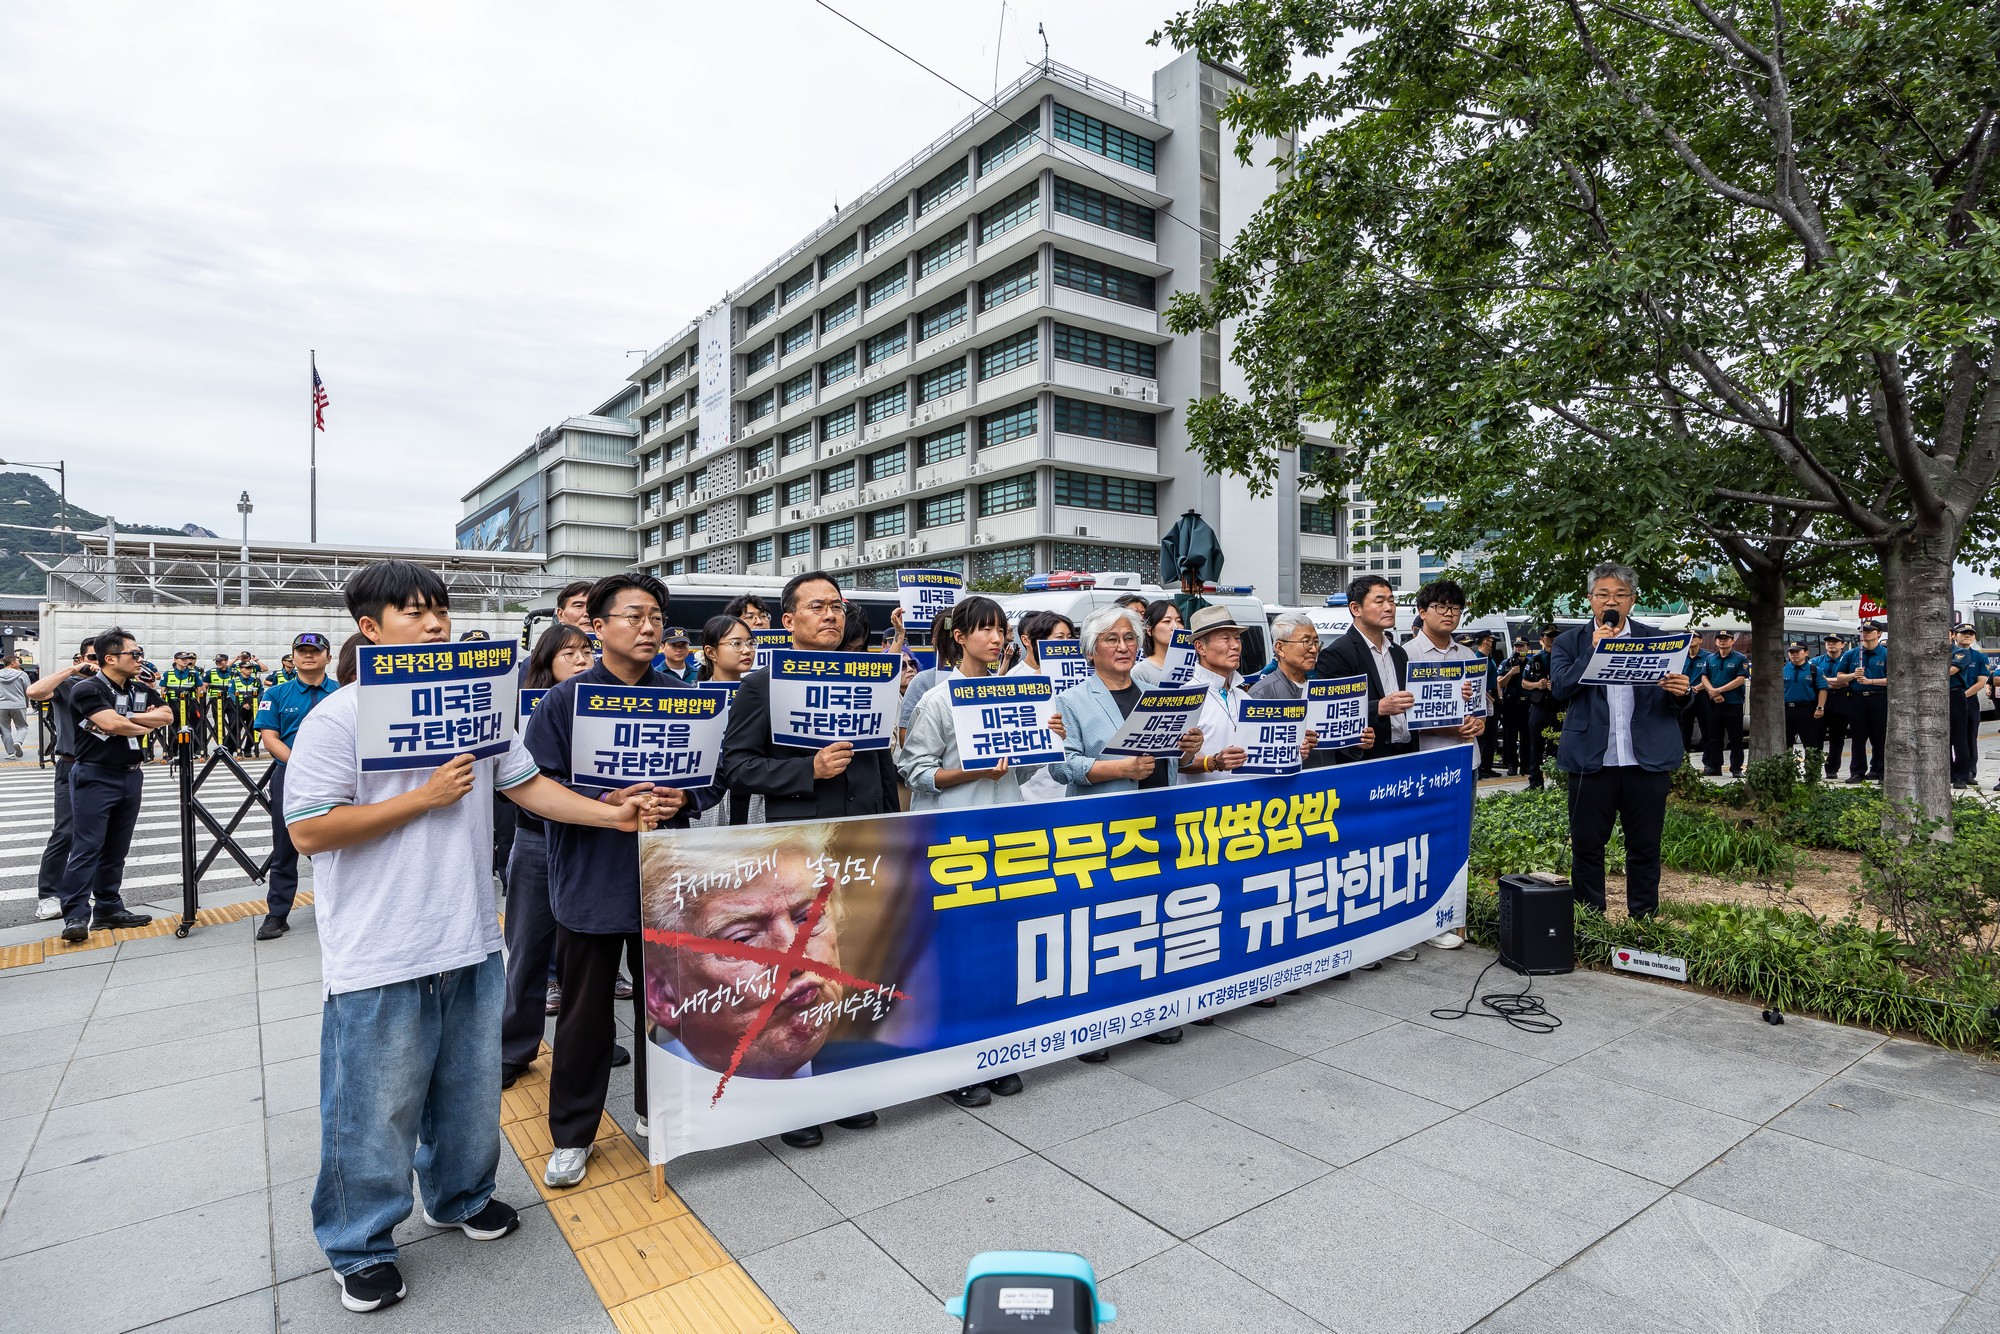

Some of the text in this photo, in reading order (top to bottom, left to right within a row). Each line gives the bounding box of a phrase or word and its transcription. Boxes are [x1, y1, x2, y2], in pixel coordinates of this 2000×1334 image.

[901, 574, 916, 582] 이란
[918, 574, 942, 584] 침략전쟁
[920, 590, 954, 604] 미국을
[1046, 646, 1078, 656] 호르무즈
[1604, 643, 1644, 652] 파병강요
[372, 648, 512, 674] 침략전쟁 파병압박
[782, 660, 893, 678] 호르무즈 파병압박
[1608, 656, 1670, 668] 트럼프를
[1412, 668, 1438, 678] 호르무즈
[412, 682, 492, 717] 미국을
[806, 686, 872, 710] 미국을
[954, 686, 974, 698] 이란
[976, 684, 1016, 698] 침략전쟁
[1018, 683, 1052, 695] 파병강요
[1310, 686, 1326, 696] 이란
[1328, 684, 1350, 696] 침략전쟁
[1422, 684, 1452, 700] 미국을
[588, 694, 716, 714] 호르무즈 파병압박
[1141, 697, 1157, 706] 이란
[1156, 696, 1184, 706] 침략전쟁
[1326, 700, 1360, 719] 미국을
[1414, 700, 1458, 718] 규탄한다!
[982, 706, 1037, 729] 미국을
[1246, 706, 1282, 718] 호르무즈
[388, 712, 502, 752] 규탄한다!
[790, 711, 882, 736] 규탄한다!
[1143, 714, 1188, 731] 미국을
[1315, 718, 1366, 738] 규탄한다!
[614, 723, 690, 748] 미국을
[972, 729, 1052, 755] 규탄한다!
[1260, 725, 1296, 743] 미국을
[594, 750, 702, 776] 규탄한다!
[1370, 766, 1461, 800] 미대사관 앞 기자회견
[926, 788, 1340, 912] 호르무즈 파병압박
[669, 848, 882, 910] 국제깡패! 날강도!
[1016, 834, 1430, 1007] 미국을 규탄한다!
[1198, 949, 1352, 1010] KT광화문빌딩(광화문역 2번 출구)
[671, 964, 896, 1026] 내정간섭! 경제수탈!
[976, 1000, 1180, 1070] 2026년 9월 10일(목) 오후 2시
